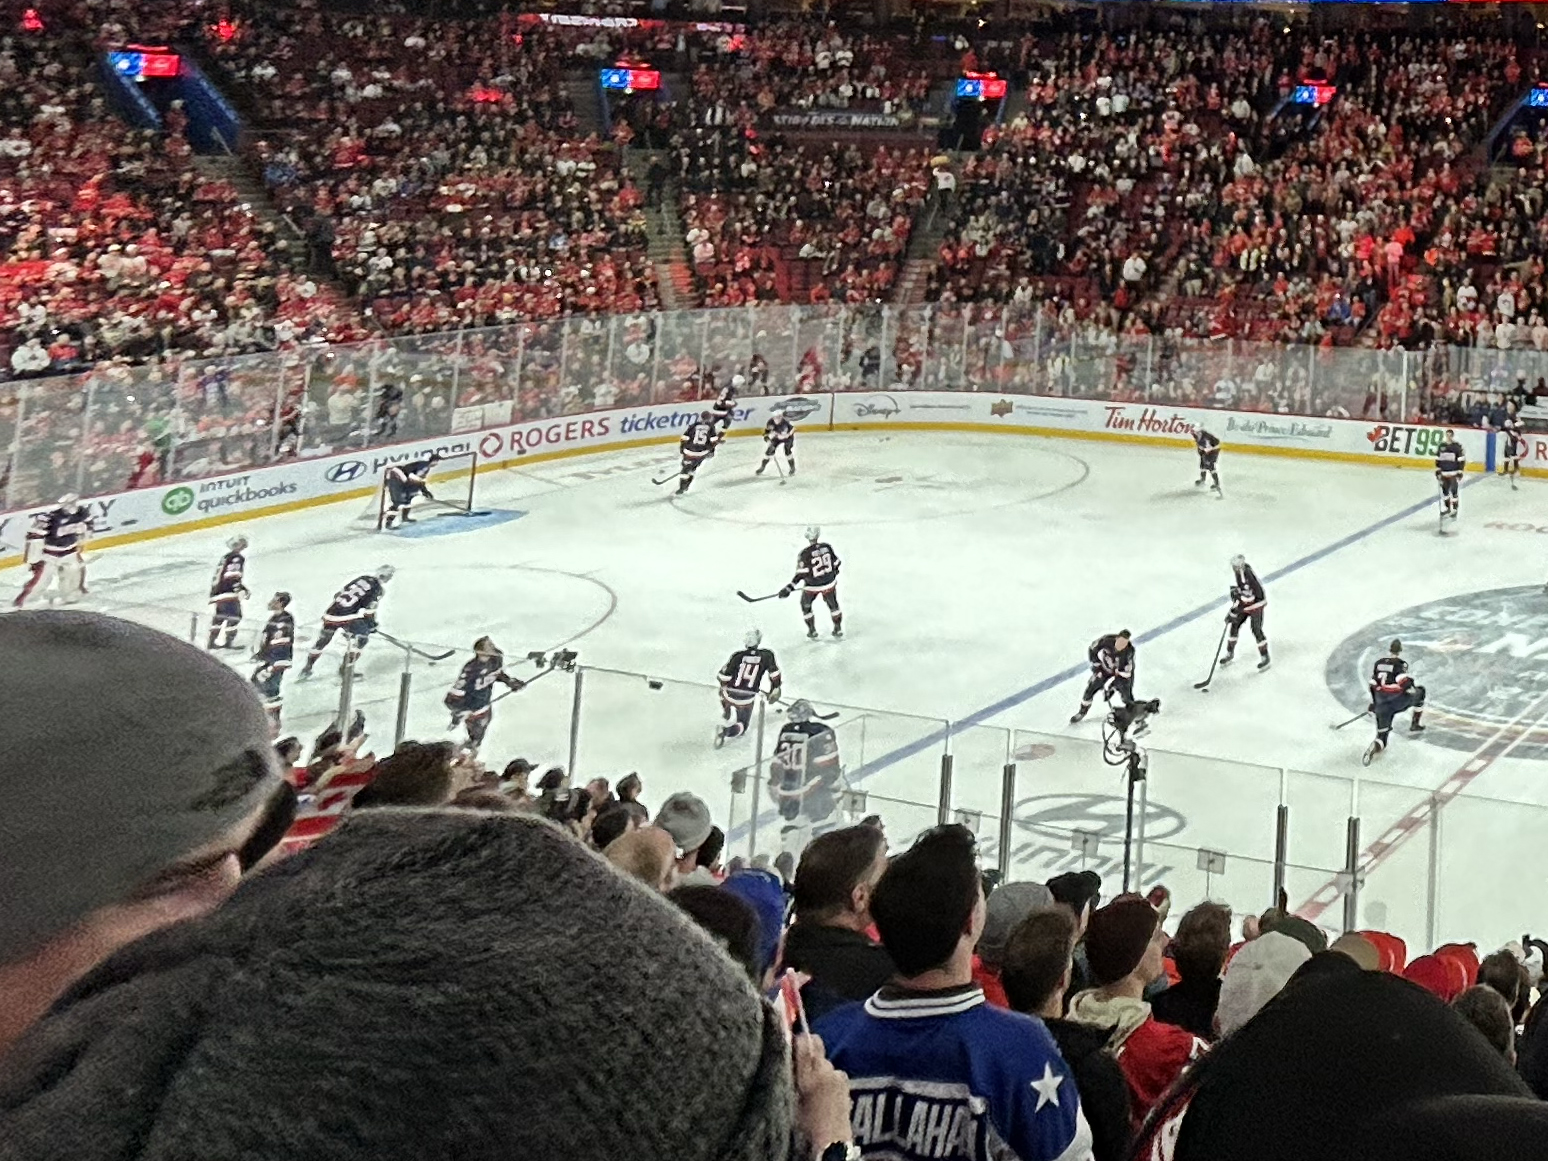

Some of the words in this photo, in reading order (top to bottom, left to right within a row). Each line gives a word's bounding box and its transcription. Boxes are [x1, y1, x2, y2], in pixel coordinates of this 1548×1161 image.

[1104, 406, 1134, 431] Tim
[1137, 408, 1196, 434] Horton
[510, 419, 610, 452] ROGERS
[197, 481, 298, 512] quickbooks
[200, 476, 250, 493] INTUIT
[812, 553, 832, 577] 29
[735, 663, 759, 688] 14
